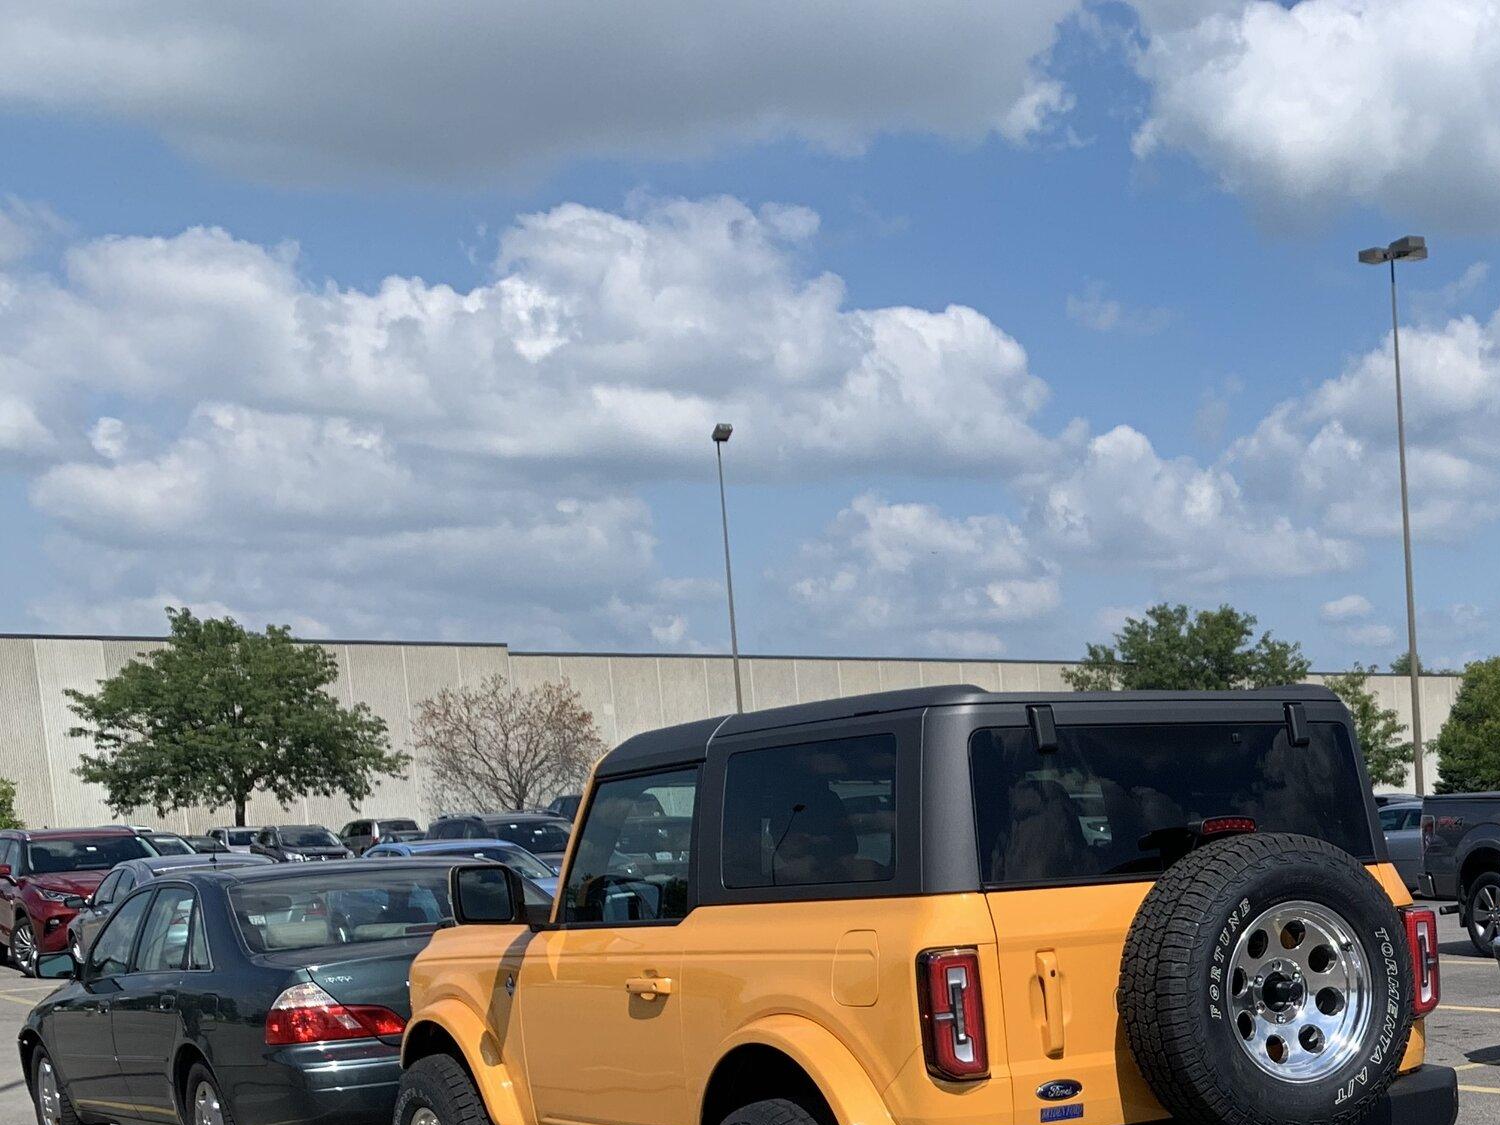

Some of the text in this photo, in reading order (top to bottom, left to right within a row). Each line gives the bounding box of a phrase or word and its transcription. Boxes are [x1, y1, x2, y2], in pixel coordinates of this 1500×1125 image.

[1210, 897, 1250, 1020] FORTUNE
[1334, 926, 1399, 1106] TORMENTA A/T
